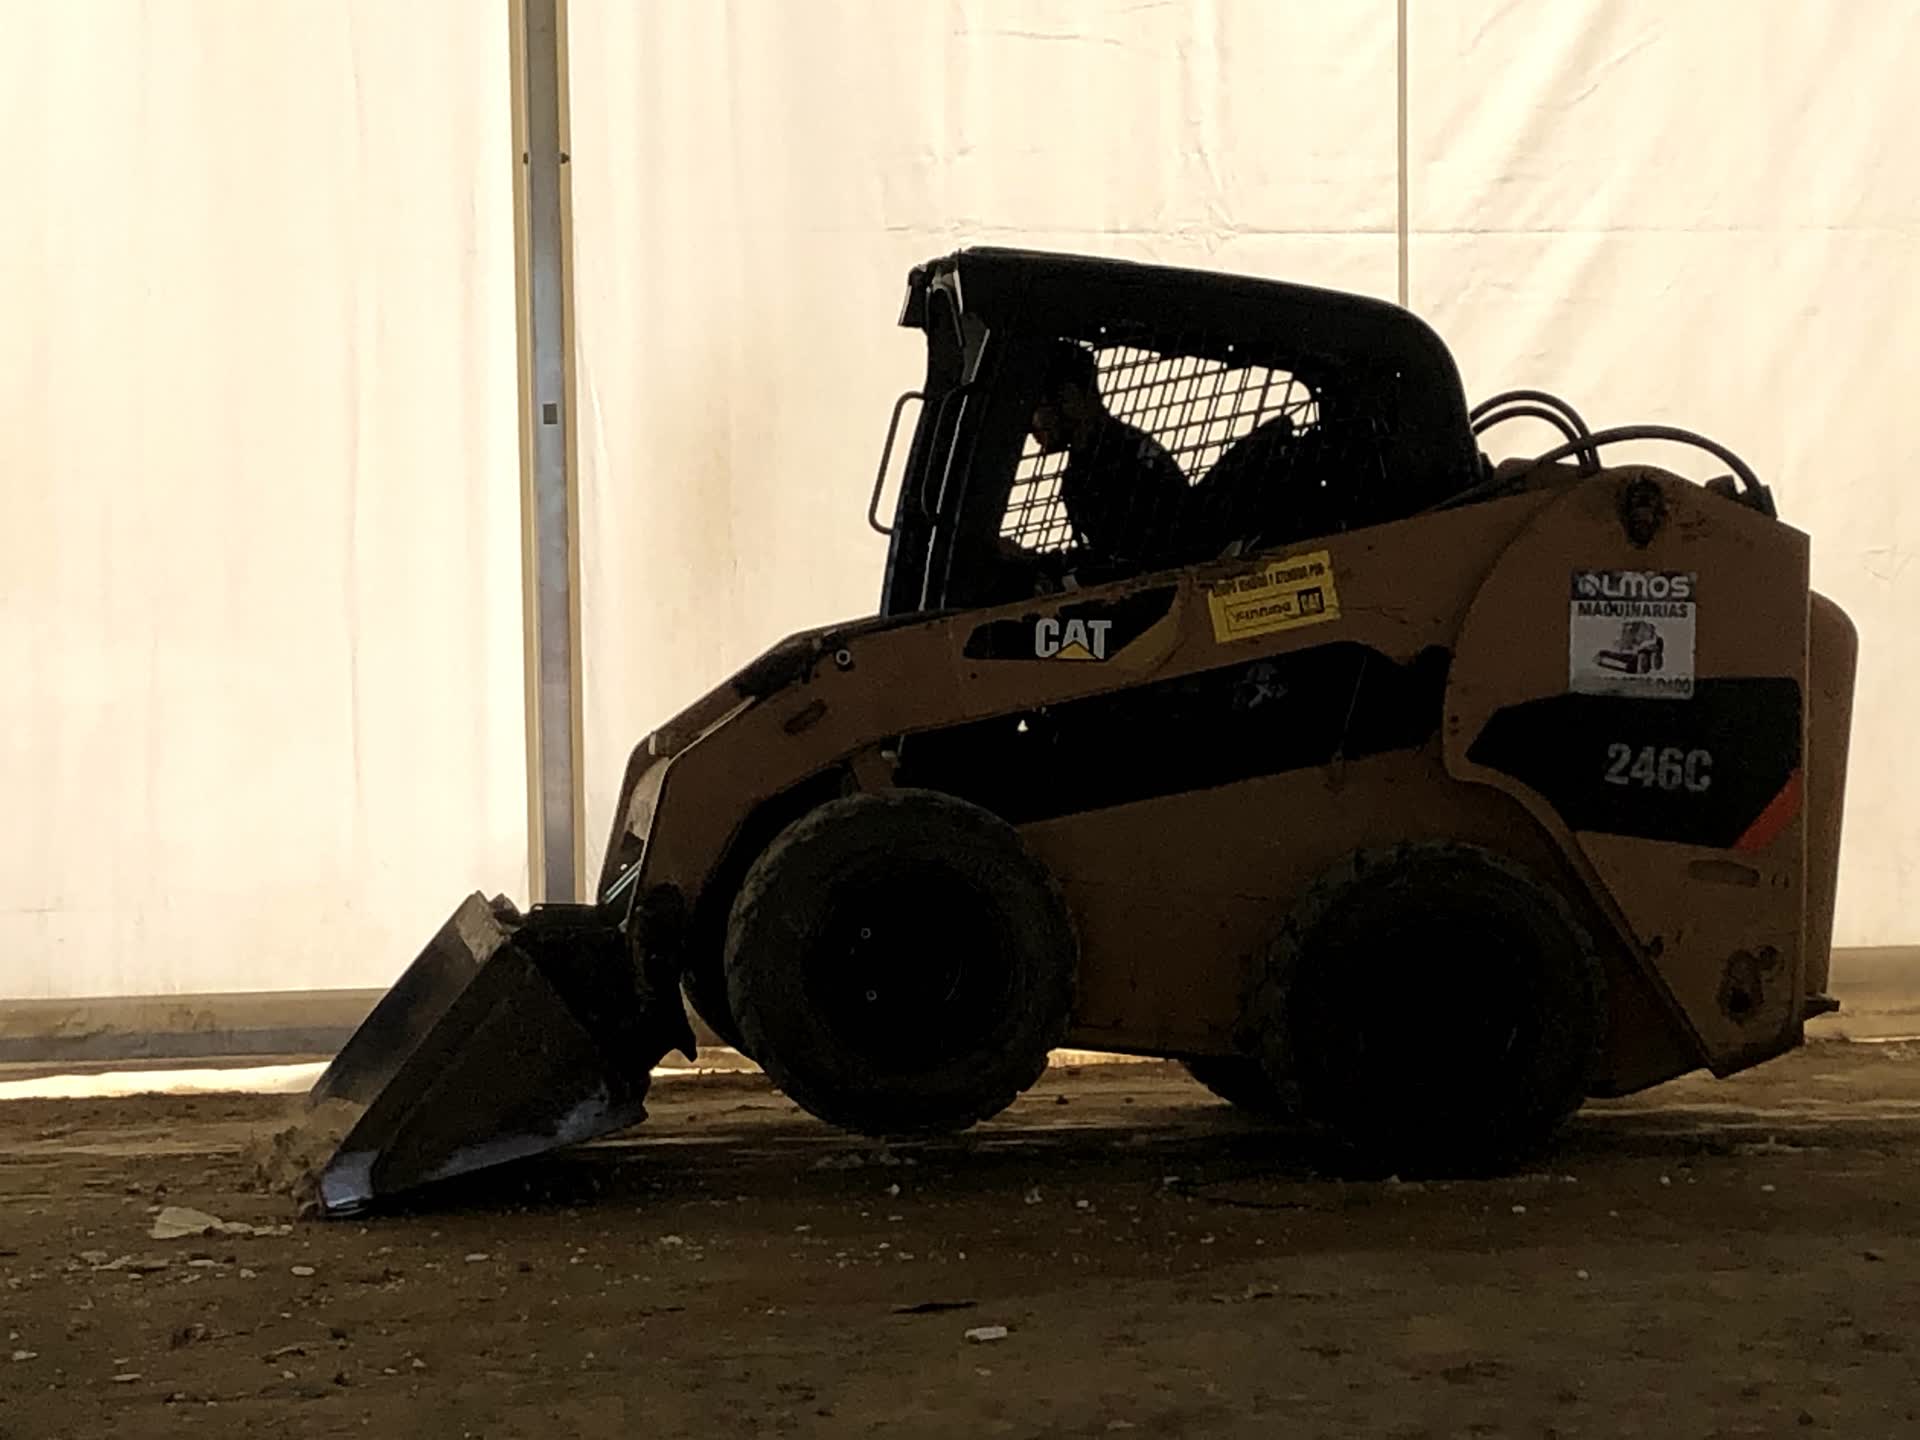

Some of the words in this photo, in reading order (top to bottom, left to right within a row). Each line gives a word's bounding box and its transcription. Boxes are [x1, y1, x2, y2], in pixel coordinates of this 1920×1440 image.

[1578, 602, 1689, 618] MAQUINARIAS
[1034, 618, 1113, 660] CAT
[1603, 742, 1714, 793] 246C
